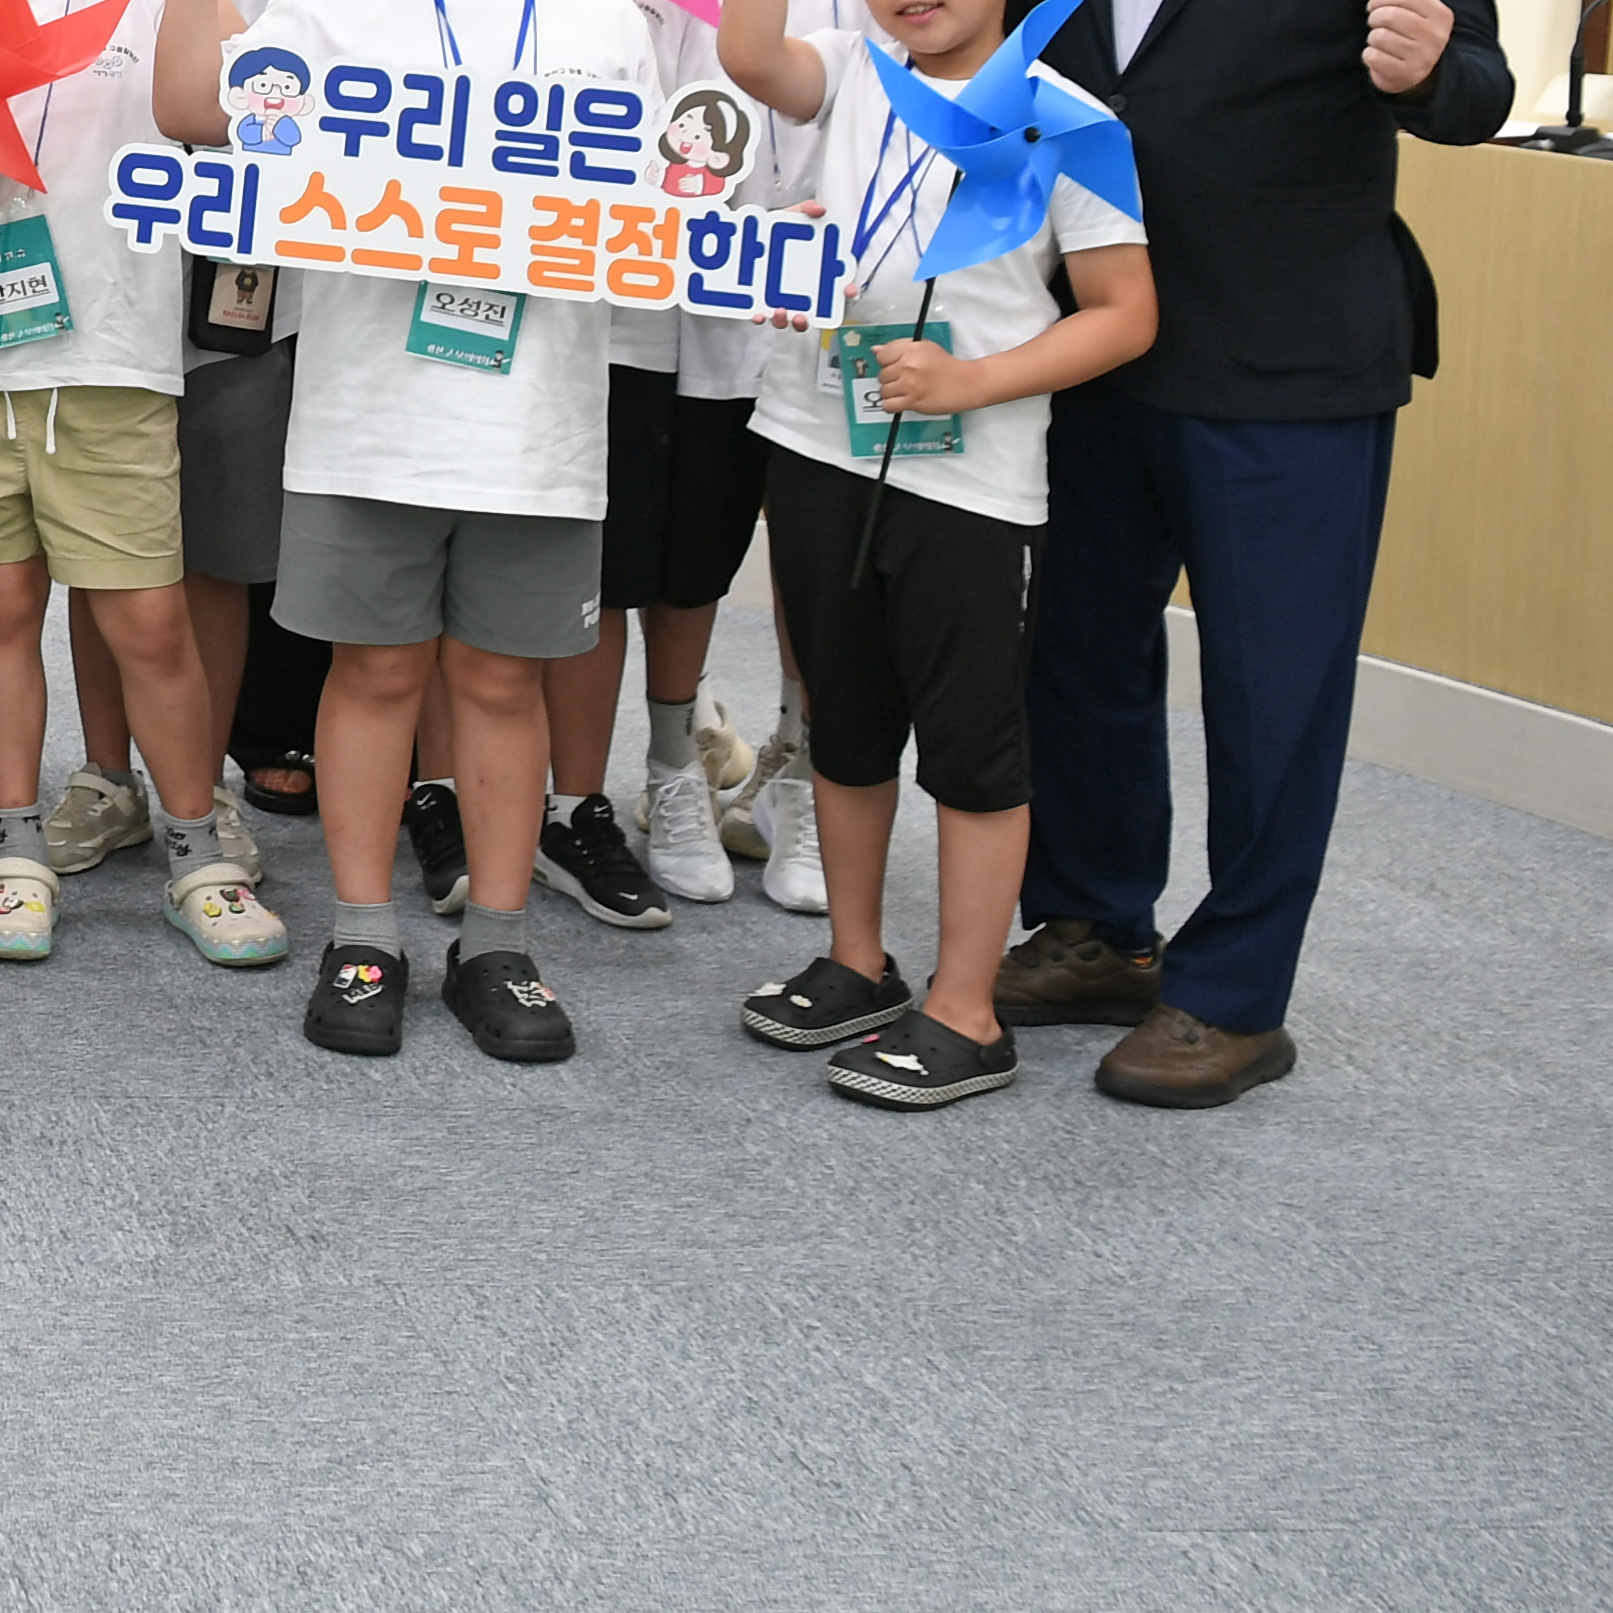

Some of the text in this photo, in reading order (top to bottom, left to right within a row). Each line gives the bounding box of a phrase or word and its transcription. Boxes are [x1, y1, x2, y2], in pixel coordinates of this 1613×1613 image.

[318, 64, 644, 185] 우리 일은
[111, 151, 848, 320] 우리 스스로 결정한다
[430, 292, 508, 324] 오성진
